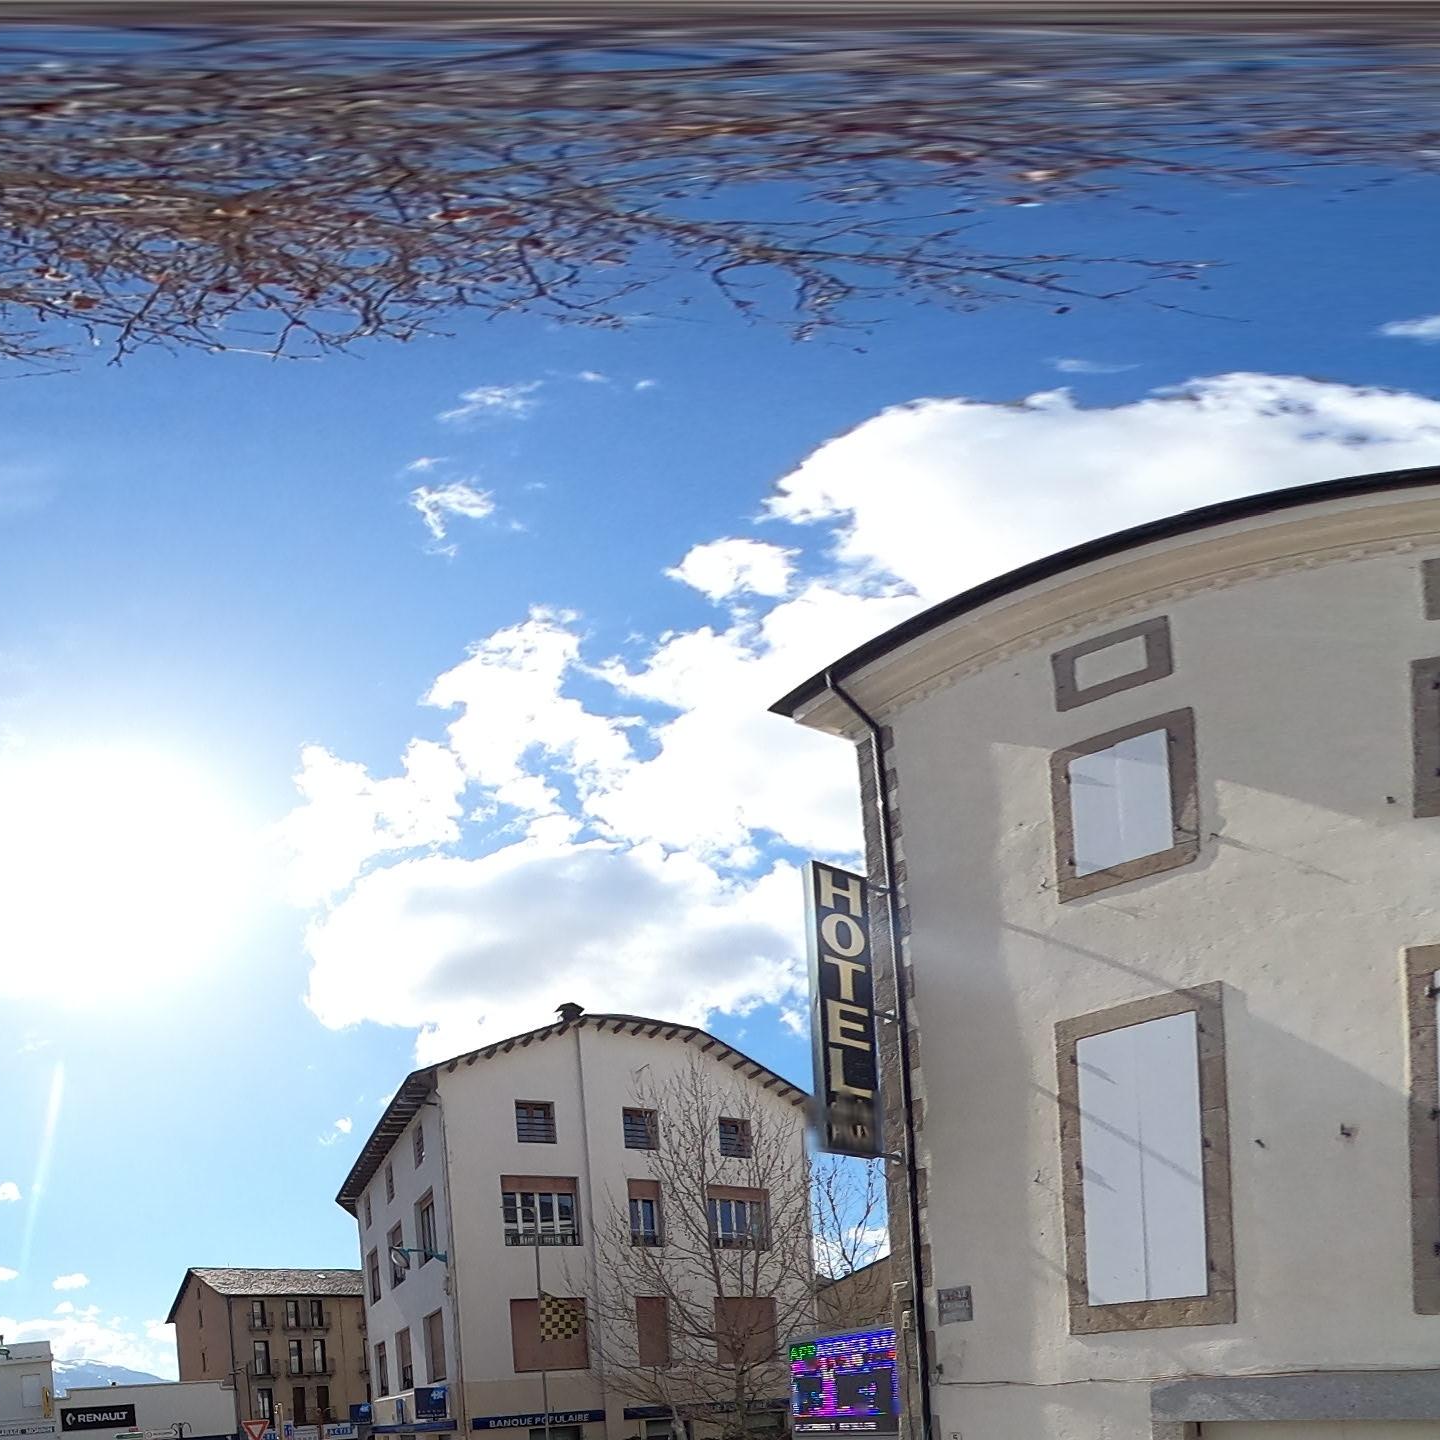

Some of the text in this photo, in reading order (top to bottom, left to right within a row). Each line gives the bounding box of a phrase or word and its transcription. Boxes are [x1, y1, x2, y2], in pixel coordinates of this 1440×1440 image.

[819, 867, 873, 1100] HOTEL
[77, 1411, 128, 1423] RENAULT
[489, 1413, 590, 1428] BANQUE POPULAIRE
